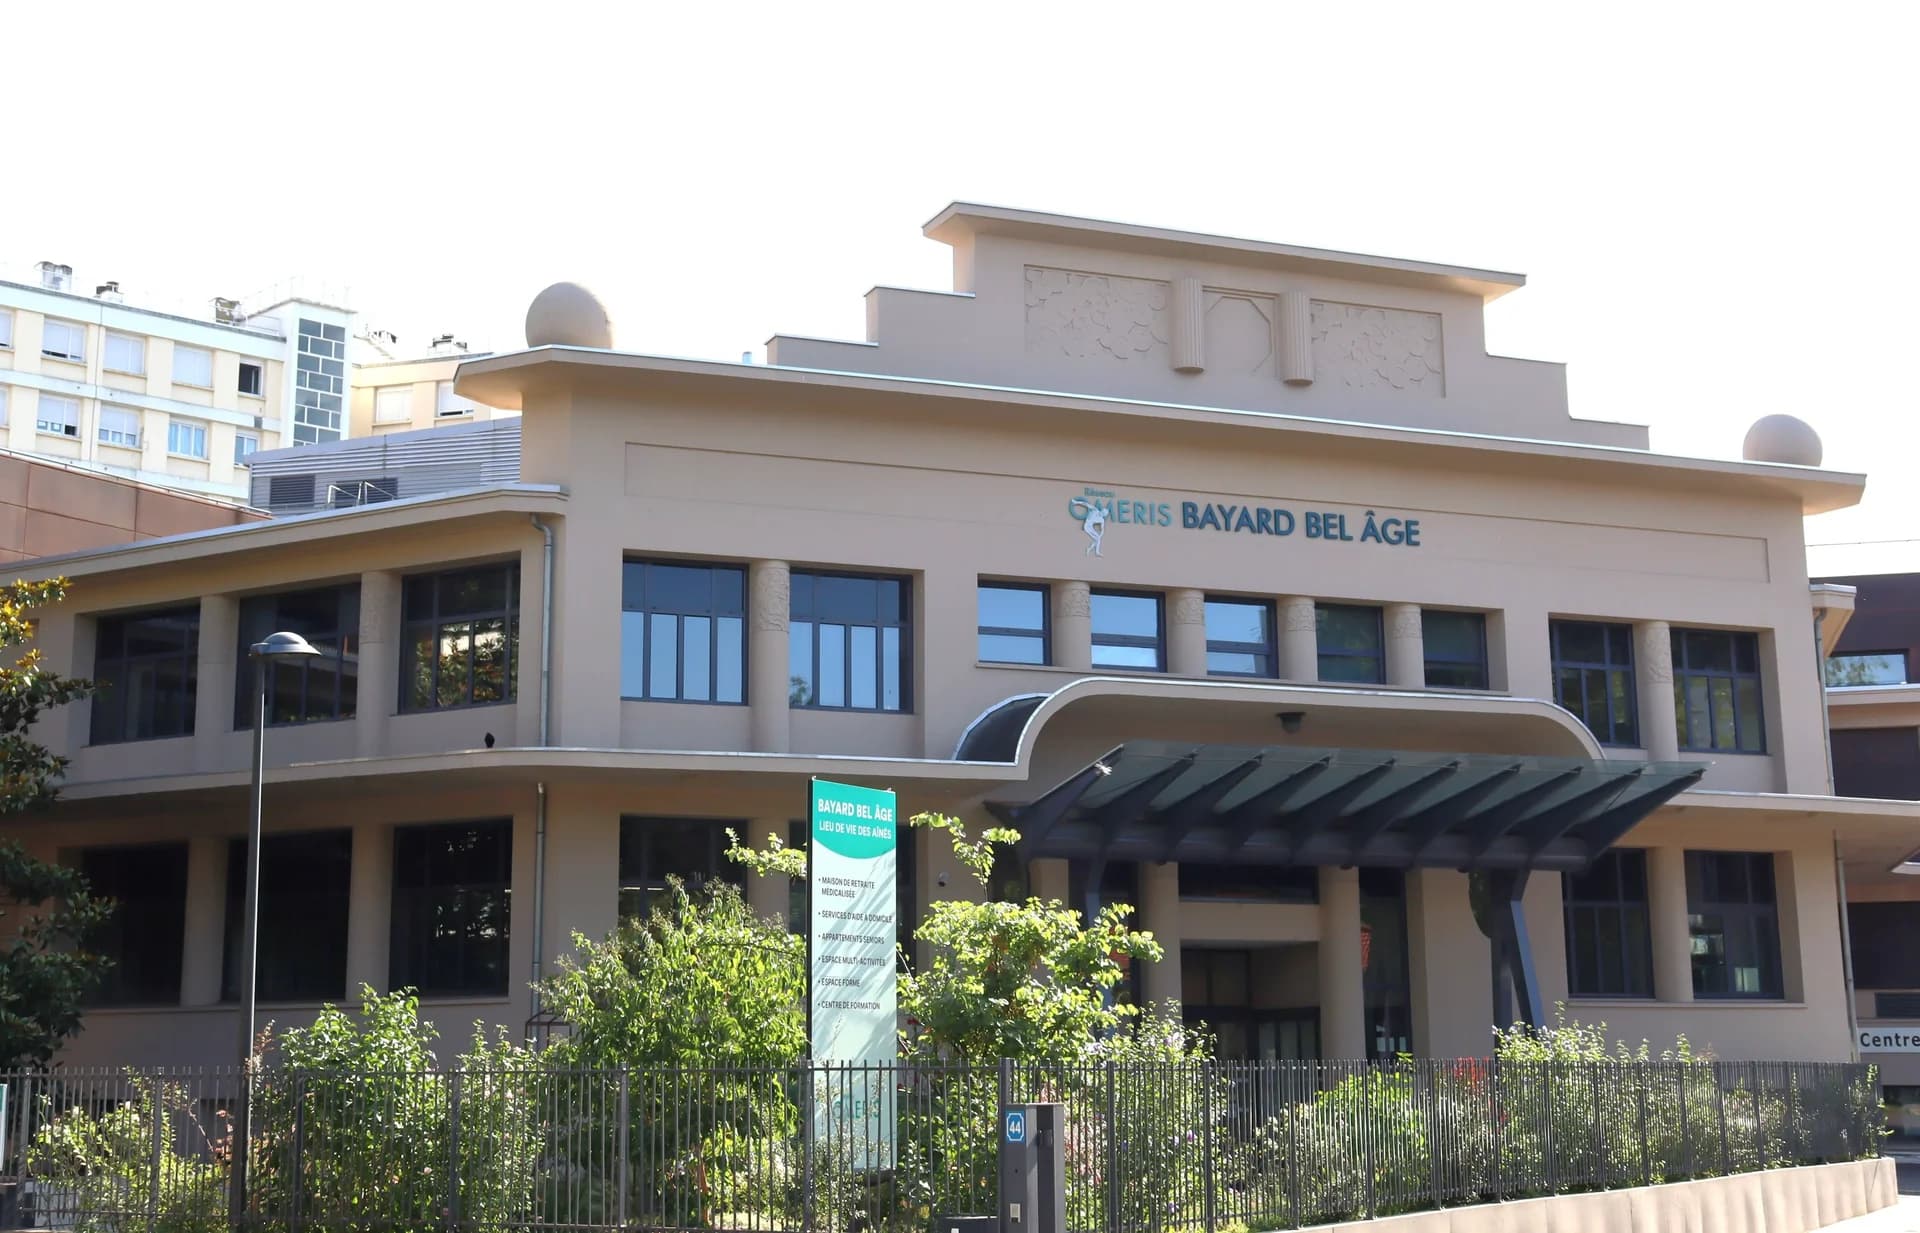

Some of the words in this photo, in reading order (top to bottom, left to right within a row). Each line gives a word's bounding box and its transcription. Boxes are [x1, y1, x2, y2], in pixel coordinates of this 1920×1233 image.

[1182, 501, 1294, 536] BAYARD
[1305, 511, 1353, 541] BEL
[1360, 510, 1421, 546] ÂGE
[818, 799, 854, 816] BAYARD
[857, 804, 872, 819] BEL
[874, 804, 892, 821] ÂGE
[819, 821, 834, 832] LIEU
[835, 823, 845, 833] DE
[846, 824, 857, 835] VIE
[858, 825, 871, 837] DES
[822, 877, 843, 886] MAISON
[844, 878, 851, 887] DE
[851, 880, 875, 889] RETRAITE
[822, 911, 847, 920] SERVICES
[868, 914, 892, 923] DOMICILE
[822, 933, 863, 943] APPARTEMENTS
[822, 955, 842, 964] ESPACE
[822, 978, 842, 986] ESPACE
[821, 1001, 843, 1009] CENTRE
[850, 1002, 880, 1010] FORMATION
[1860, 1032, 1920, 1047] Centre
[1009, 1120, 1021, 1134] 44
